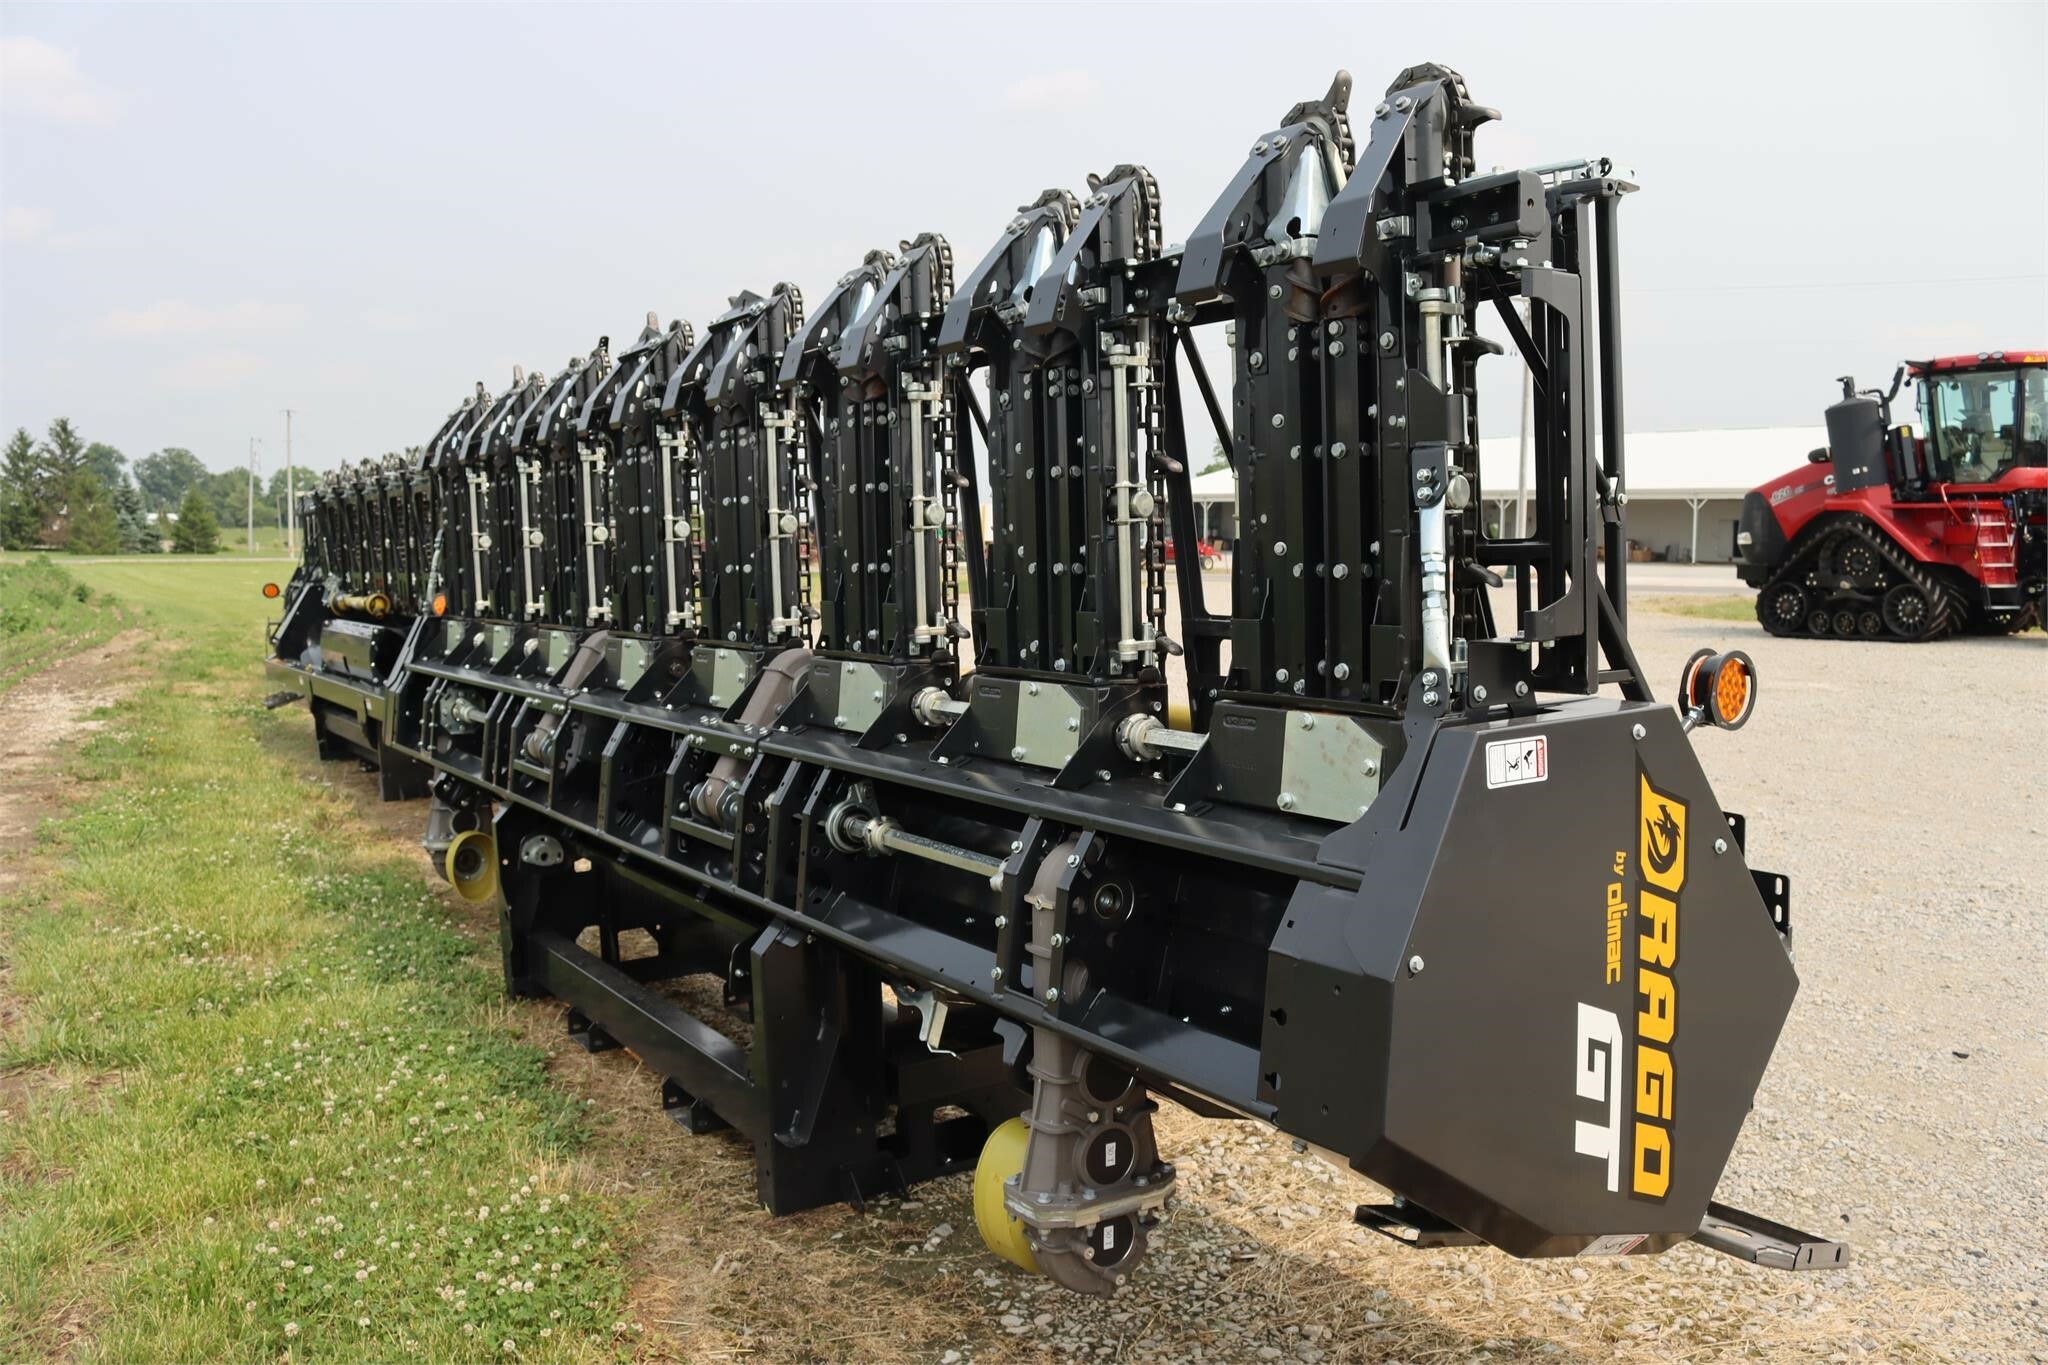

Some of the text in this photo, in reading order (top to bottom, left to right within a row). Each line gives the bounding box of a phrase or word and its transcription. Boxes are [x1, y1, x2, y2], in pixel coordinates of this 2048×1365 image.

[1606, 851, 1628, 985] by olimac
[1634, 772, 1686, 1198] DRAGO
[1575, 1002, 1623, 1192] GT
